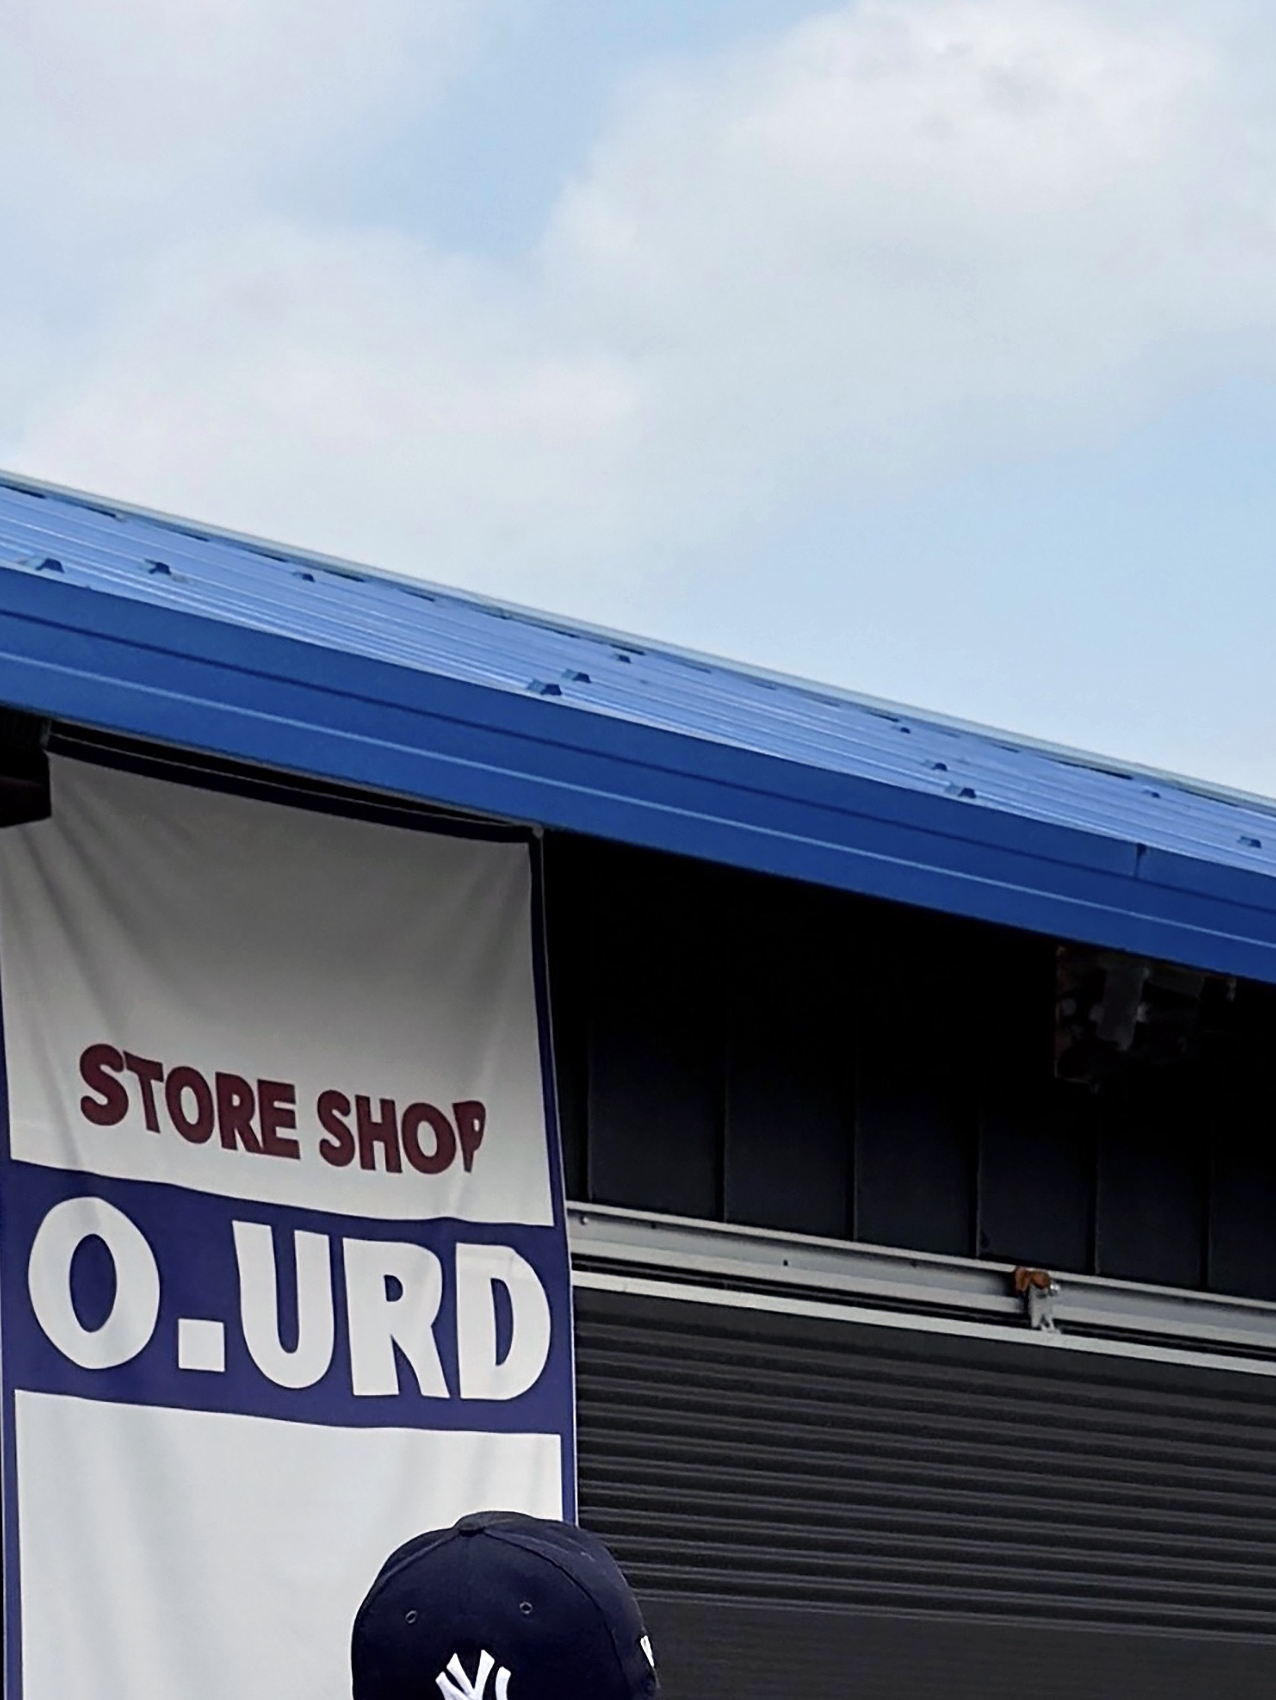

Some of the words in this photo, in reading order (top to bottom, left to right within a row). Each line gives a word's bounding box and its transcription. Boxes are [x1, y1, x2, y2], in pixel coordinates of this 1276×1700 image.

[79, 1043, 301, 1161] STORE
[317, 1089, 486, 1174] SHOP
[28, 1197, 552, 1401] O.URD
